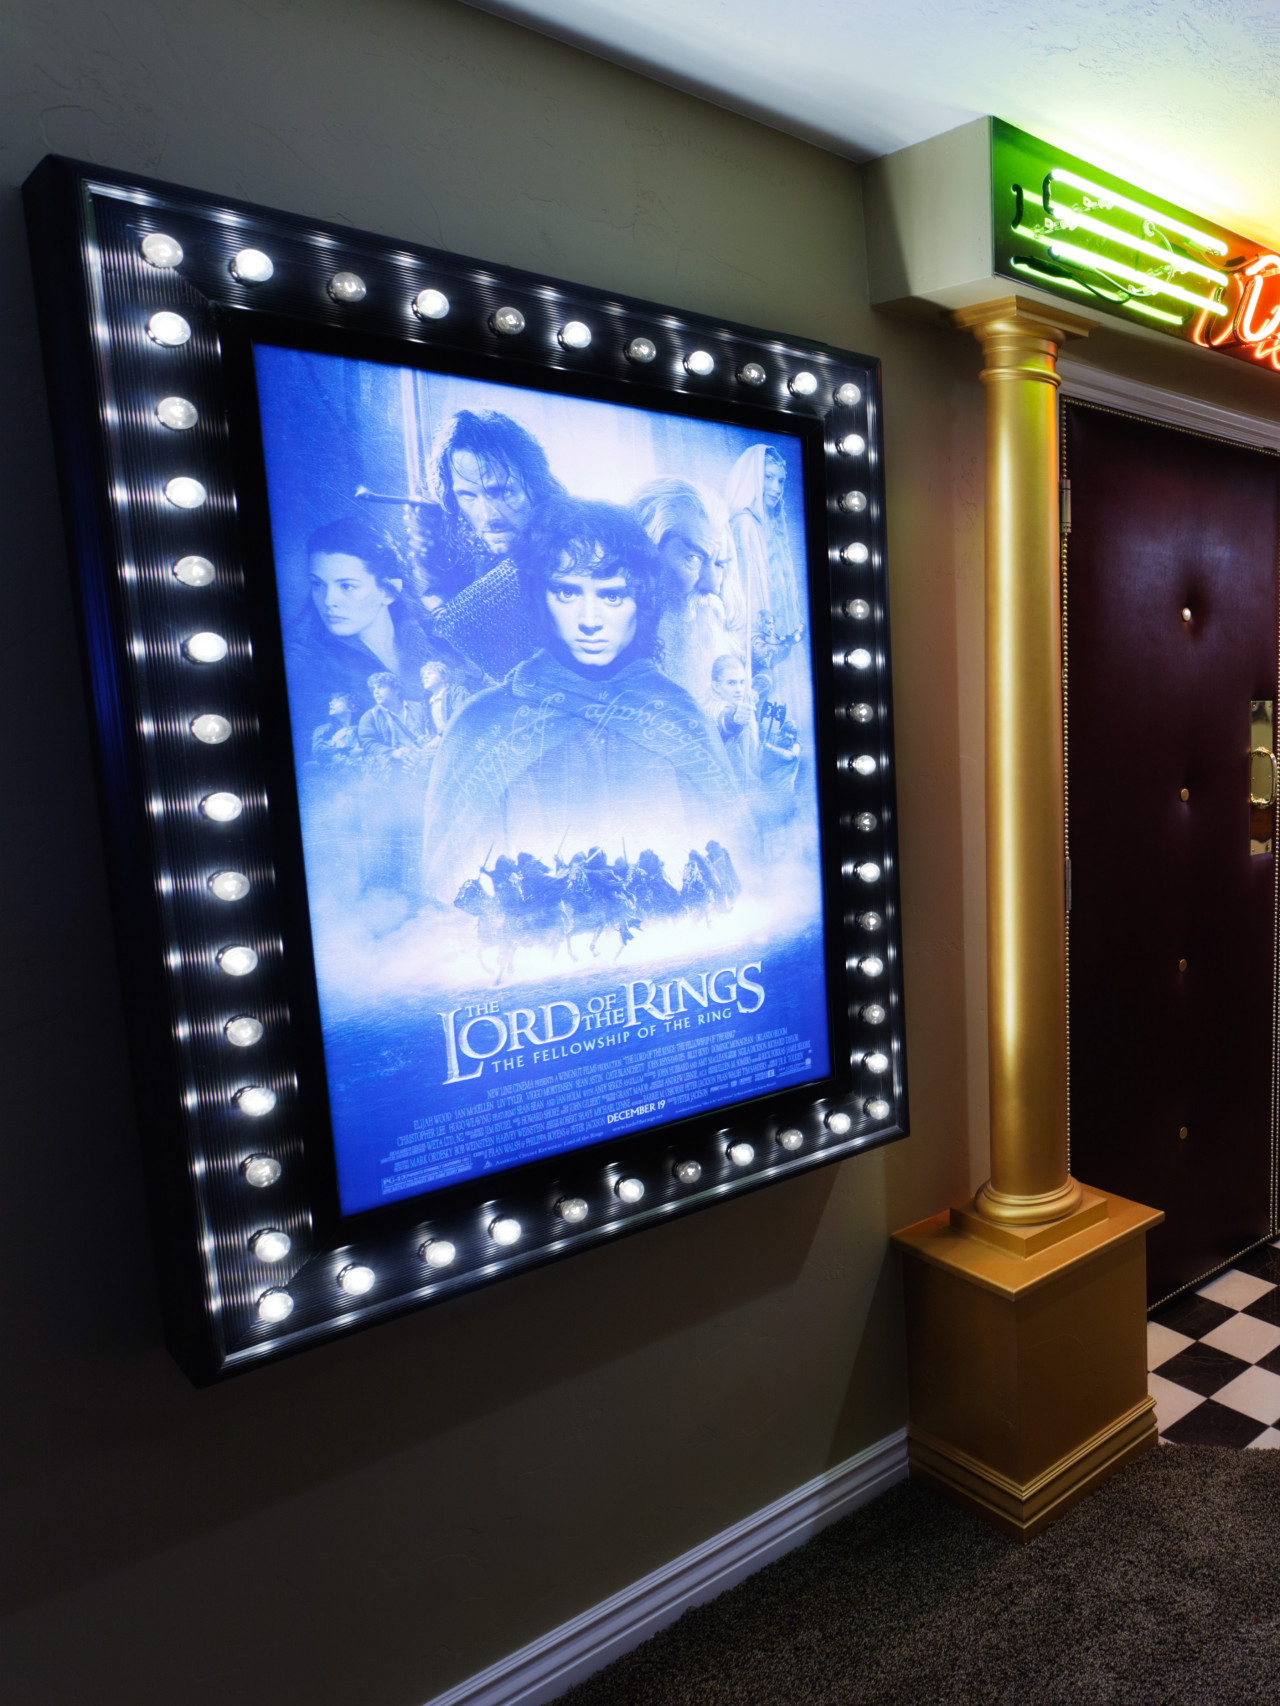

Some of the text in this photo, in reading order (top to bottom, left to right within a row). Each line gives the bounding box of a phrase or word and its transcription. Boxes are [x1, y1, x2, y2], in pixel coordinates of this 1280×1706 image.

[438, 961, 765, 1085] THE LORD OF THE RINGS
[491, 1008, 732, 1072] THE FELLOWSHIP OF THE RING
[607, 1099, 666, 1124] DECEMBER 19
